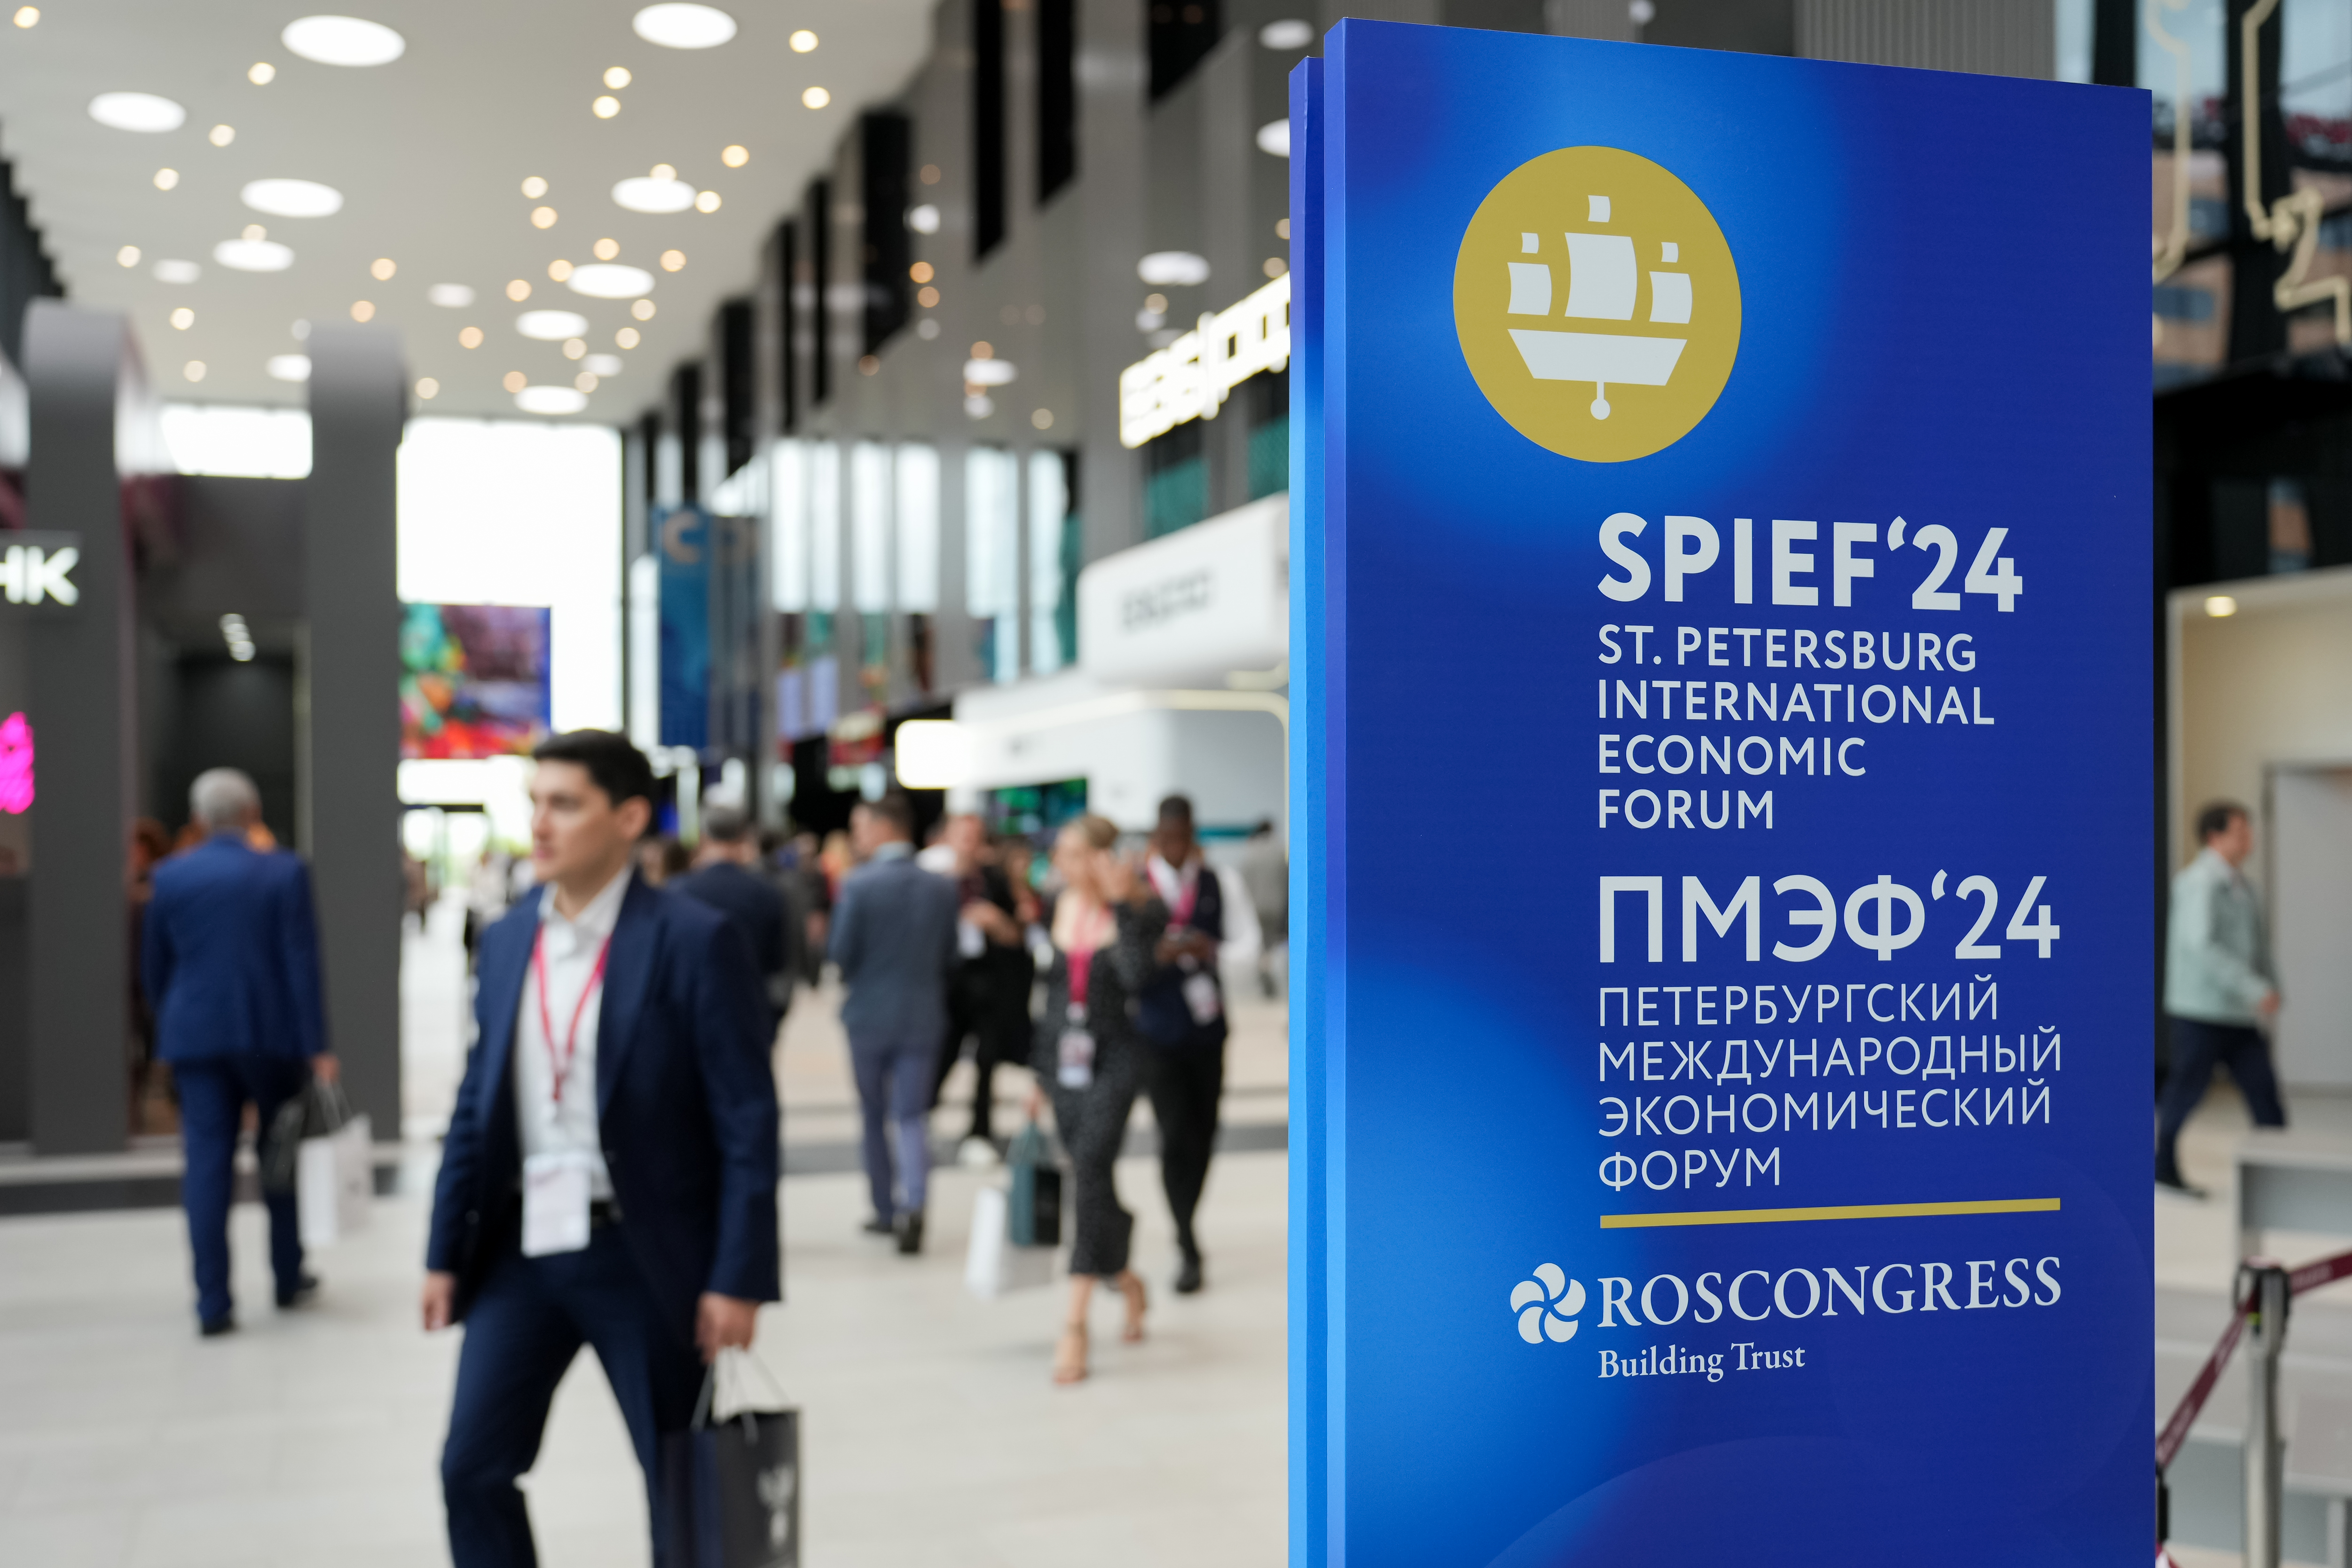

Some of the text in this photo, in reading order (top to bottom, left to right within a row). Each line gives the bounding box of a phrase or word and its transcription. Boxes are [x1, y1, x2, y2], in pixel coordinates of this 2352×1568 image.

[1598, 624, 1975, 672] ST. PETERSBURG
[1599, 679, 1994, 725] INTERNATIONAL
[1599, 734, 1866, 776] ECONOMIC
[1599, 789, 1773, 829] FORUM
[1600, 974, 1997, 1026] ПЕТЕРБУРГСКИЙ
[1600, 1025, 2061, 1086] МЕЖДУНАРОДНЫЙ
[1598, 1078, 2050, 1137] ЭКОНОМИЧЕСКИЙ
[1599, 1147, 1780, 1191] ФОРУМ
[1597, 1256, 2061, 1327] ROSCONGRESS
[1598, 1342, 1805, 1382] Building Trust
